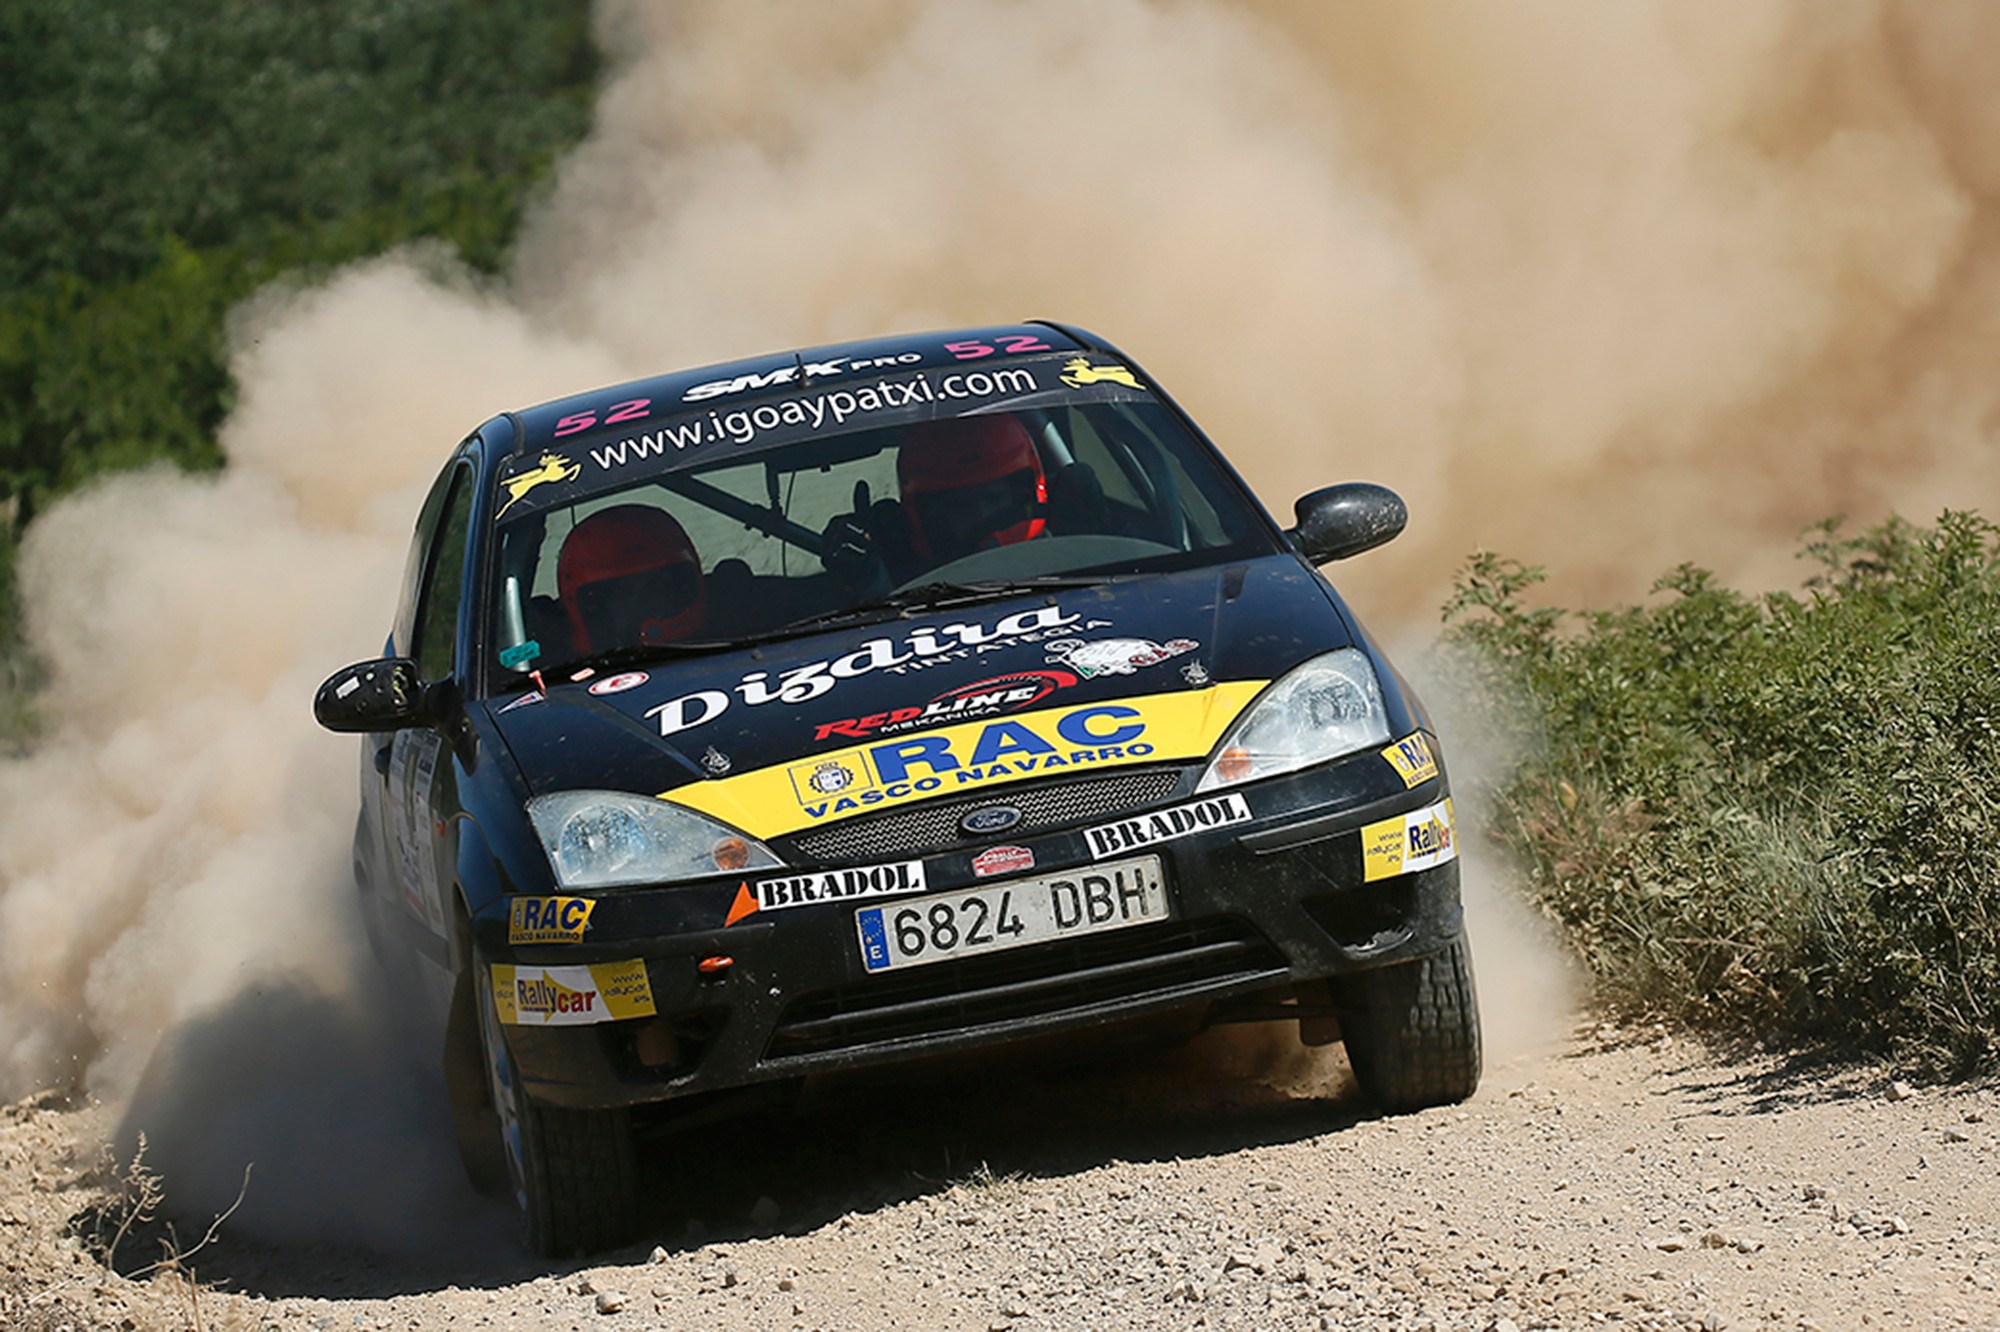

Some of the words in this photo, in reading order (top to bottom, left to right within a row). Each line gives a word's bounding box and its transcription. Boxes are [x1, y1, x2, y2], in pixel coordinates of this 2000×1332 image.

[850, 352, 922, 371] PRO
[944, 335, 1051, 360] 52
[553, 398, 651, 438] 52
[590, 368, 1037, 470] www.igoaypatxi.com
[880, 705, 1001, 734] MEKANIKA
[869, 705, 1146, 785] RAC
[804, 777, 942, 819] VASCO
[957, 742, 1154, 784] NAVARRO
[1090, 798, 1245, 855] BRADOL
[762, 864, 920, 907] BRADOL
[524, 899, 587, 931] RAC
[870, 945, 884, 960] E
[894, 890, 1024, 957] 6824
[1050, 867, 1148, 929] DBH
[516, 979, 597, 1013] Rallycar
